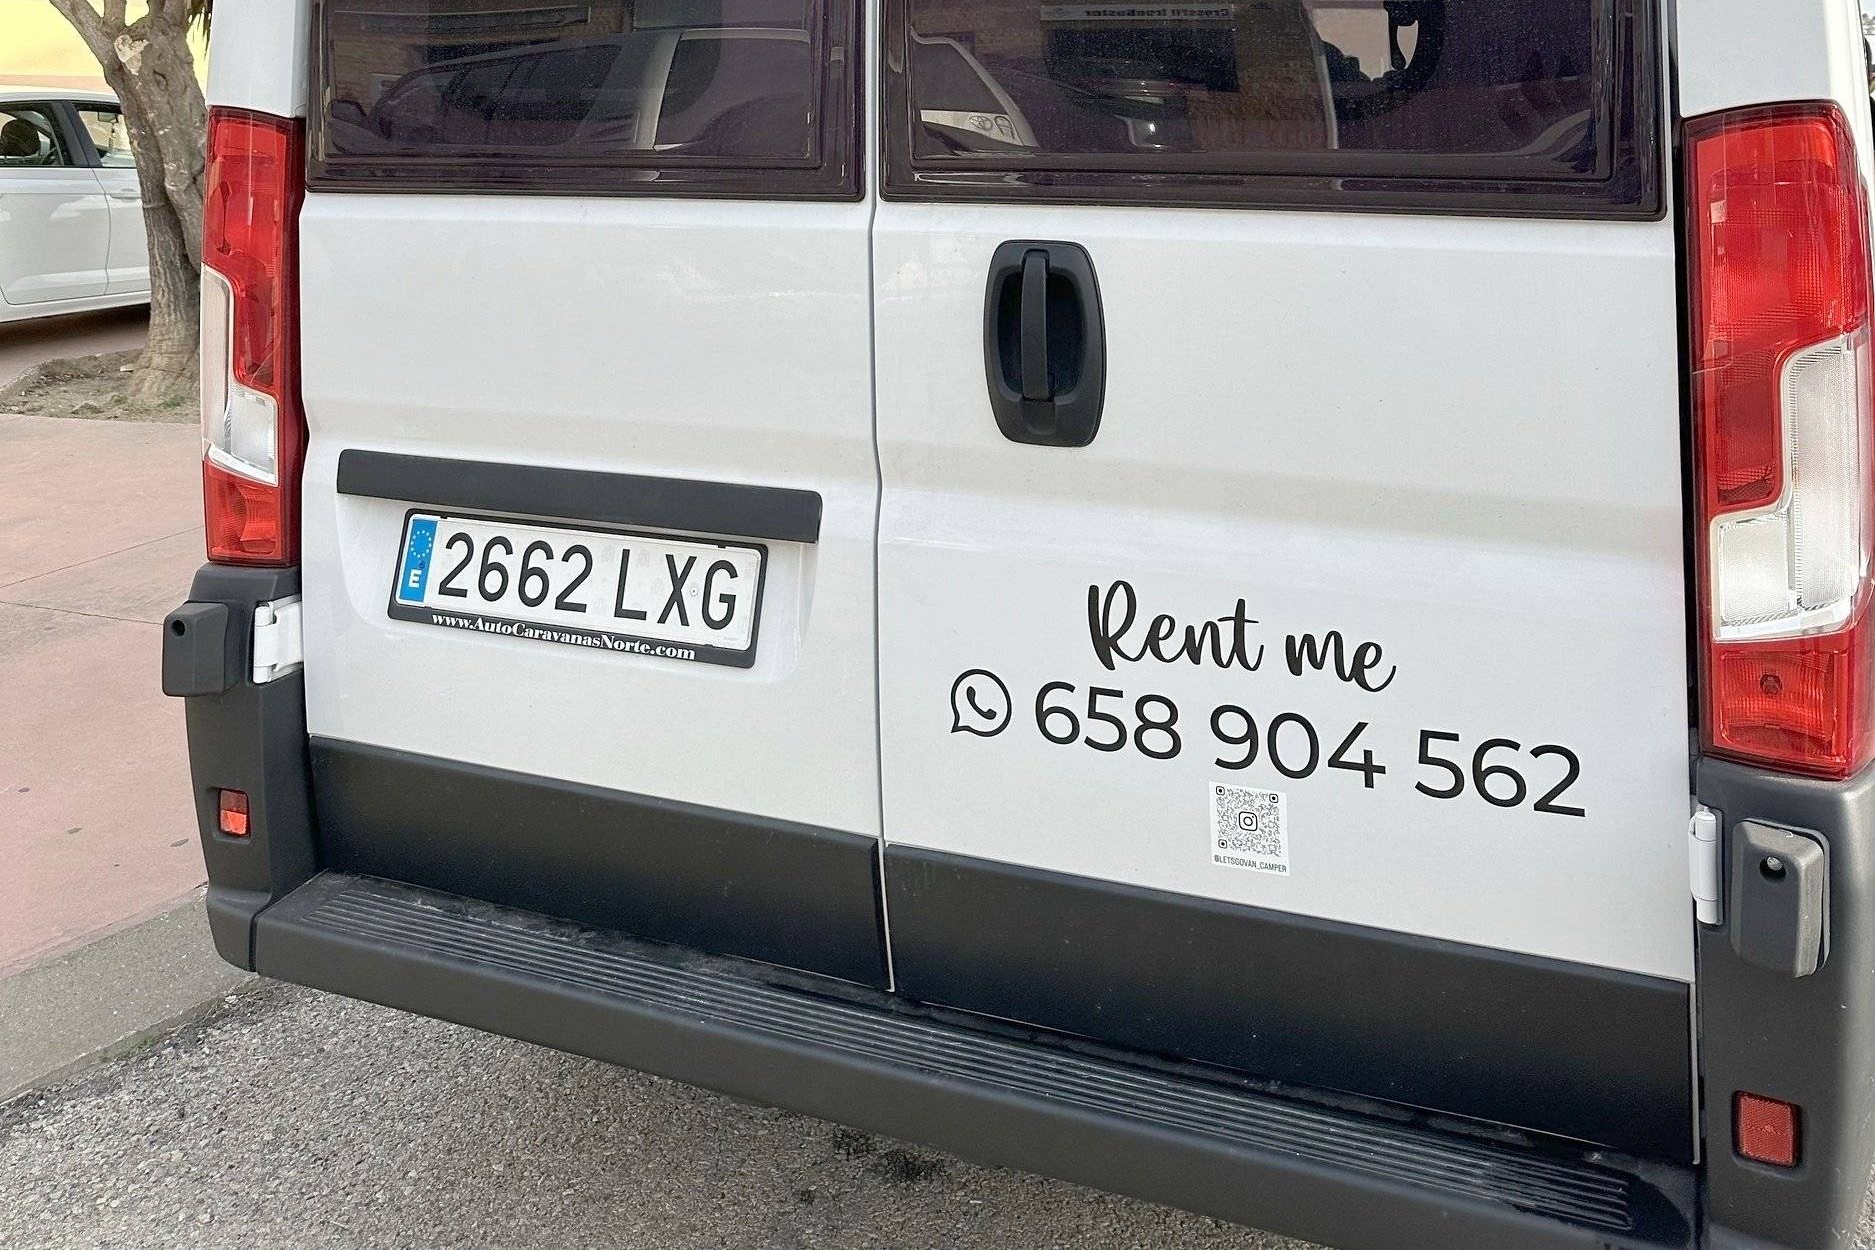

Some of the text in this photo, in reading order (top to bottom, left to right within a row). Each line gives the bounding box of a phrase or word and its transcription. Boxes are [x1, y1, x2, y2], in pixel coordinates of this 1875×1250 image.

[408, 531, 739, 631] E 2662 LXG
[431, 612, 697, 661] www.AutoCaravanasNorte.com
[1087, 579, 1397, 693] Rent me
[1034, 680, 1587, 819] 658 904 562
[1213, 853, 1288, 874] @LETSGOVAN_CAMPER
